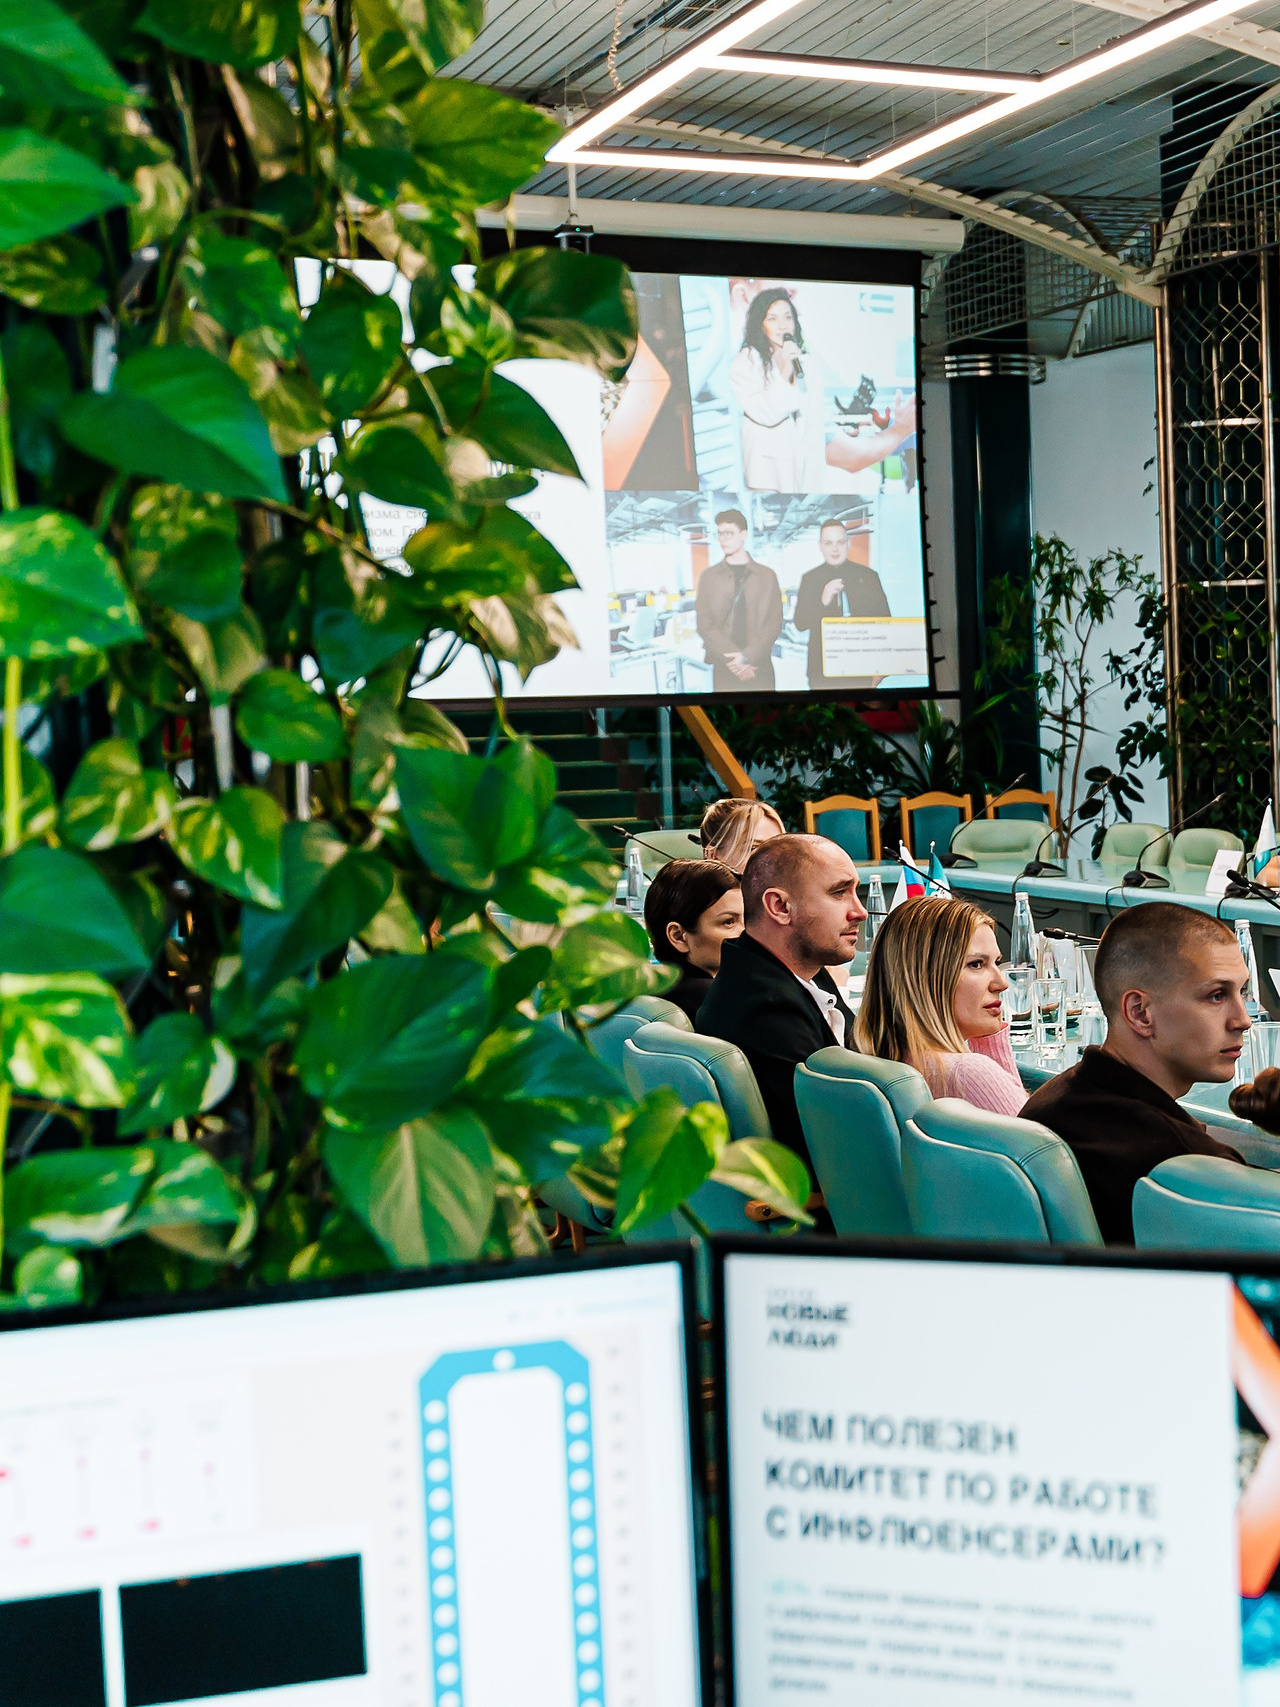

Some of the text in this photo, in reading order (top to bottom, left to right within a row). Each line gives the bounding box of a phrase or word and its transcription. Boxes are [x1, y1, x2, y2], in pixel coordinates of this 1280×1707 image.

[763, 1411, 1018, 1455] ЧЕМ ПОЛЕЗЕН
[765, 1460, 1158, 1518] КОМИТЕТ ПО РАБОТЕ
[765, 1506, 789, 1538] С
